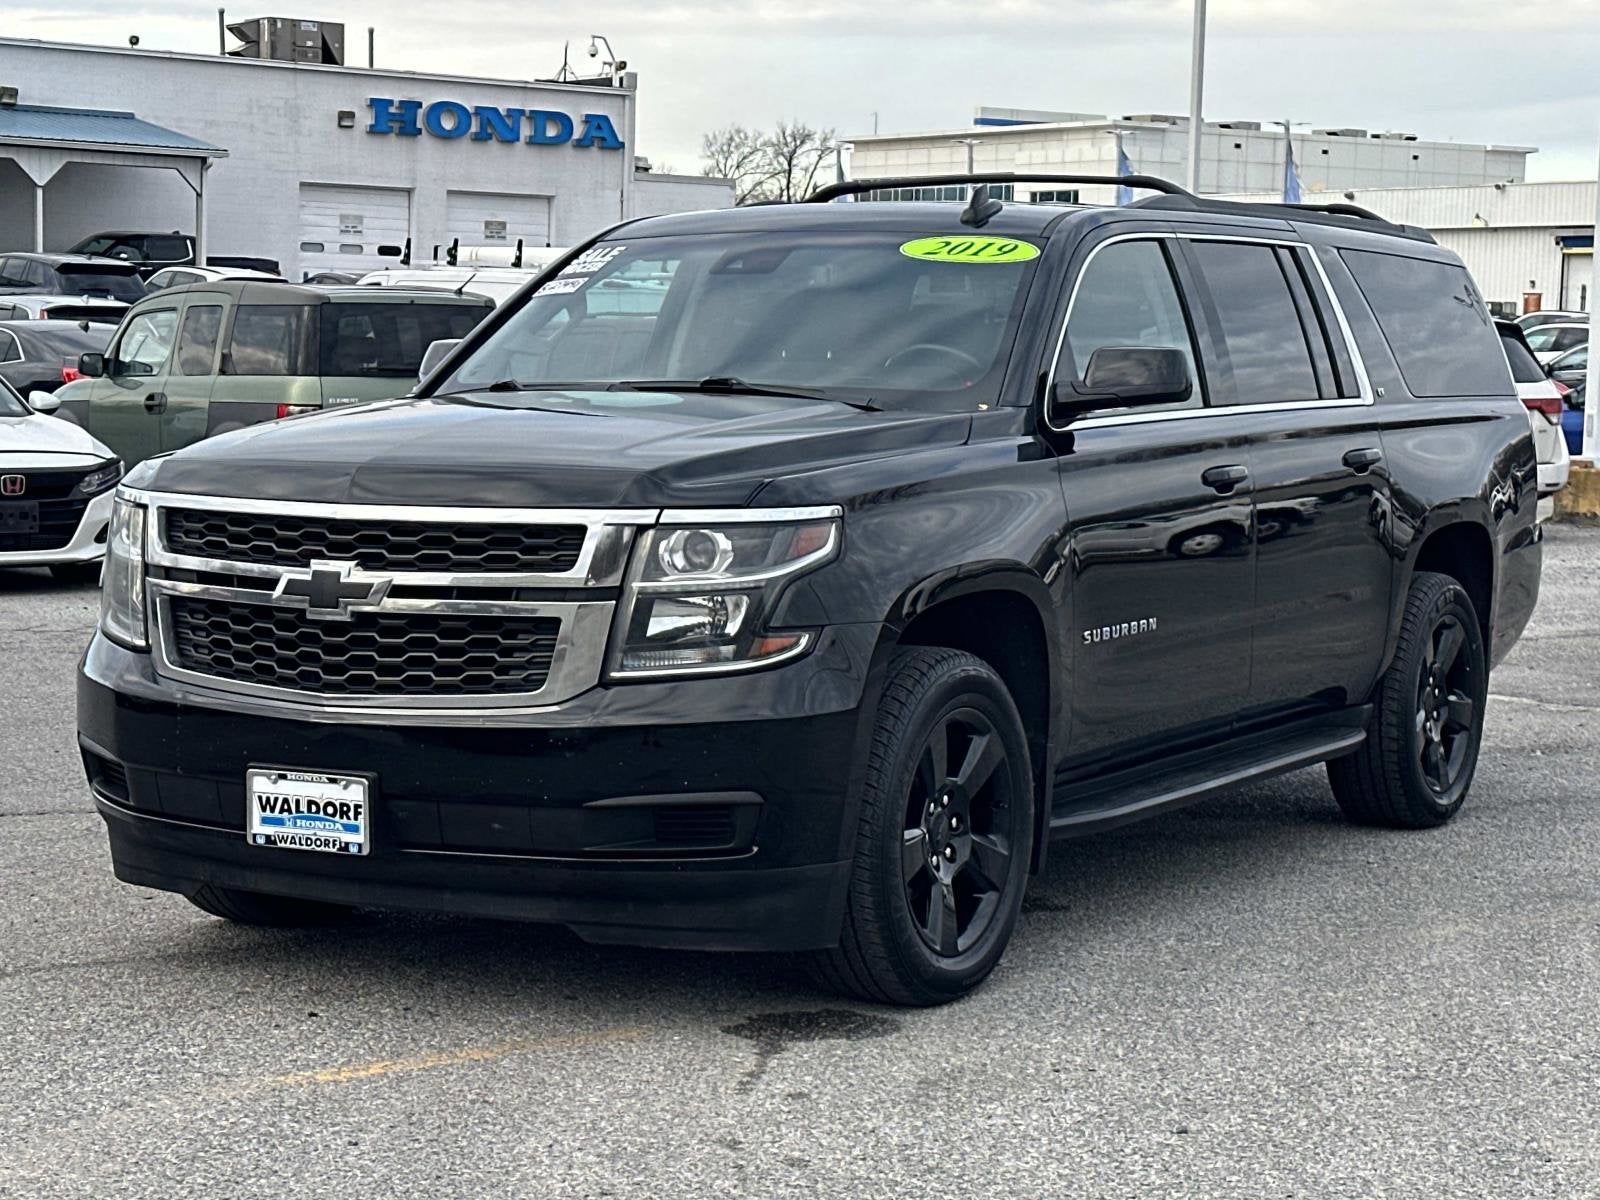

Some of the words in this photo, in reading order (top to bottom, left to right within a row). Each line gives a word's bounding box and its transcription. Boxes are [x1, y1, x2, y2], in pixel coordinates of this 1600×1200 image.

[366, 97, 625, 149] HONDA
[922, 240, 1019, 257] 2019
[1083, 617, 1157, 644] SUBURBAN
[286, 773, 330, 783] HONDA
[257, 795, 362, 821] WALDORF
[295, 819, 344, 831] HONDA
[277, 834, 339, 849] WALDORF
